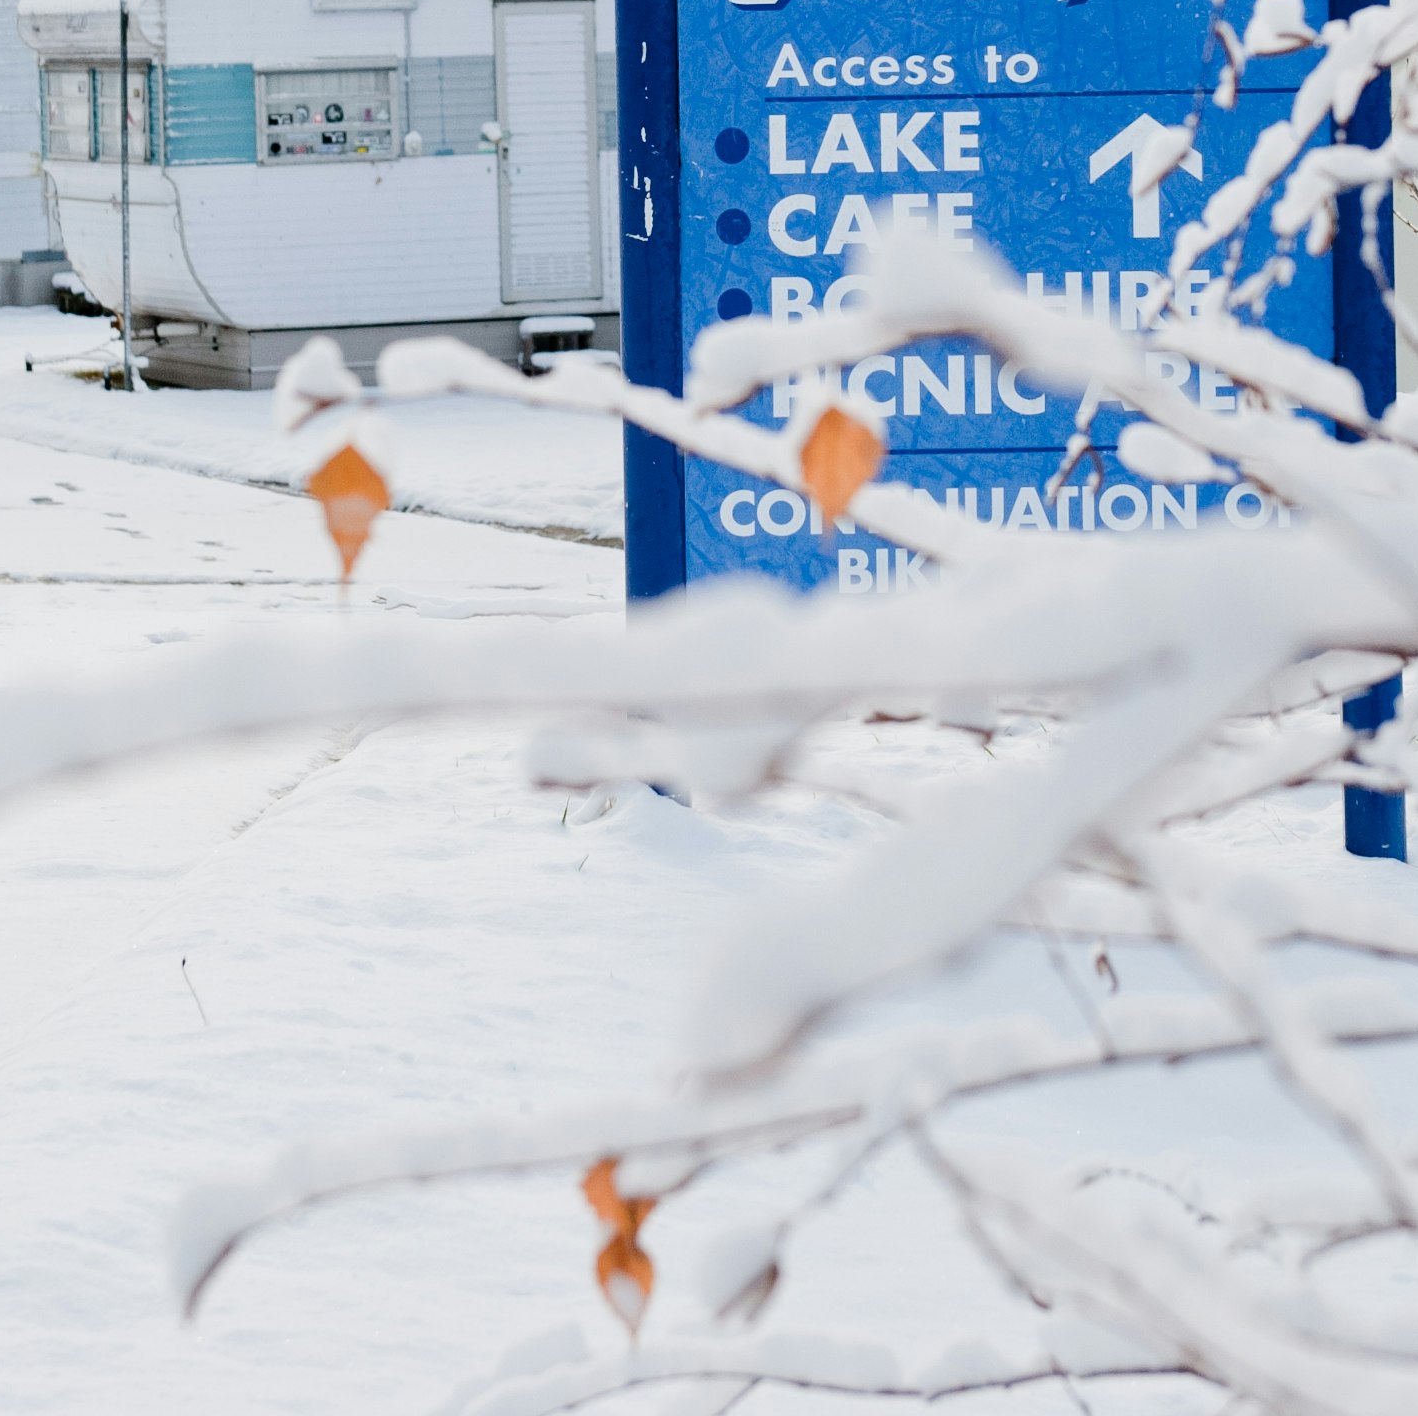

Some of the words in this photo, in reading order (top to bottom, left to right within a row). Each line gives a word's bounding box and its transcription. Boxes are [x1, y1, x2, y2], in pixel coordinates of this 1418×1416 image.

[765, 43, 955, 87] Access
[984, 45, 1039, 84] to
[768, 111, 981, 175] LAKE
[767, 192, 974, 257] CAFE
[1078, 350, 1303, 413] ARE
[838, 548, 947, 594] BIK
